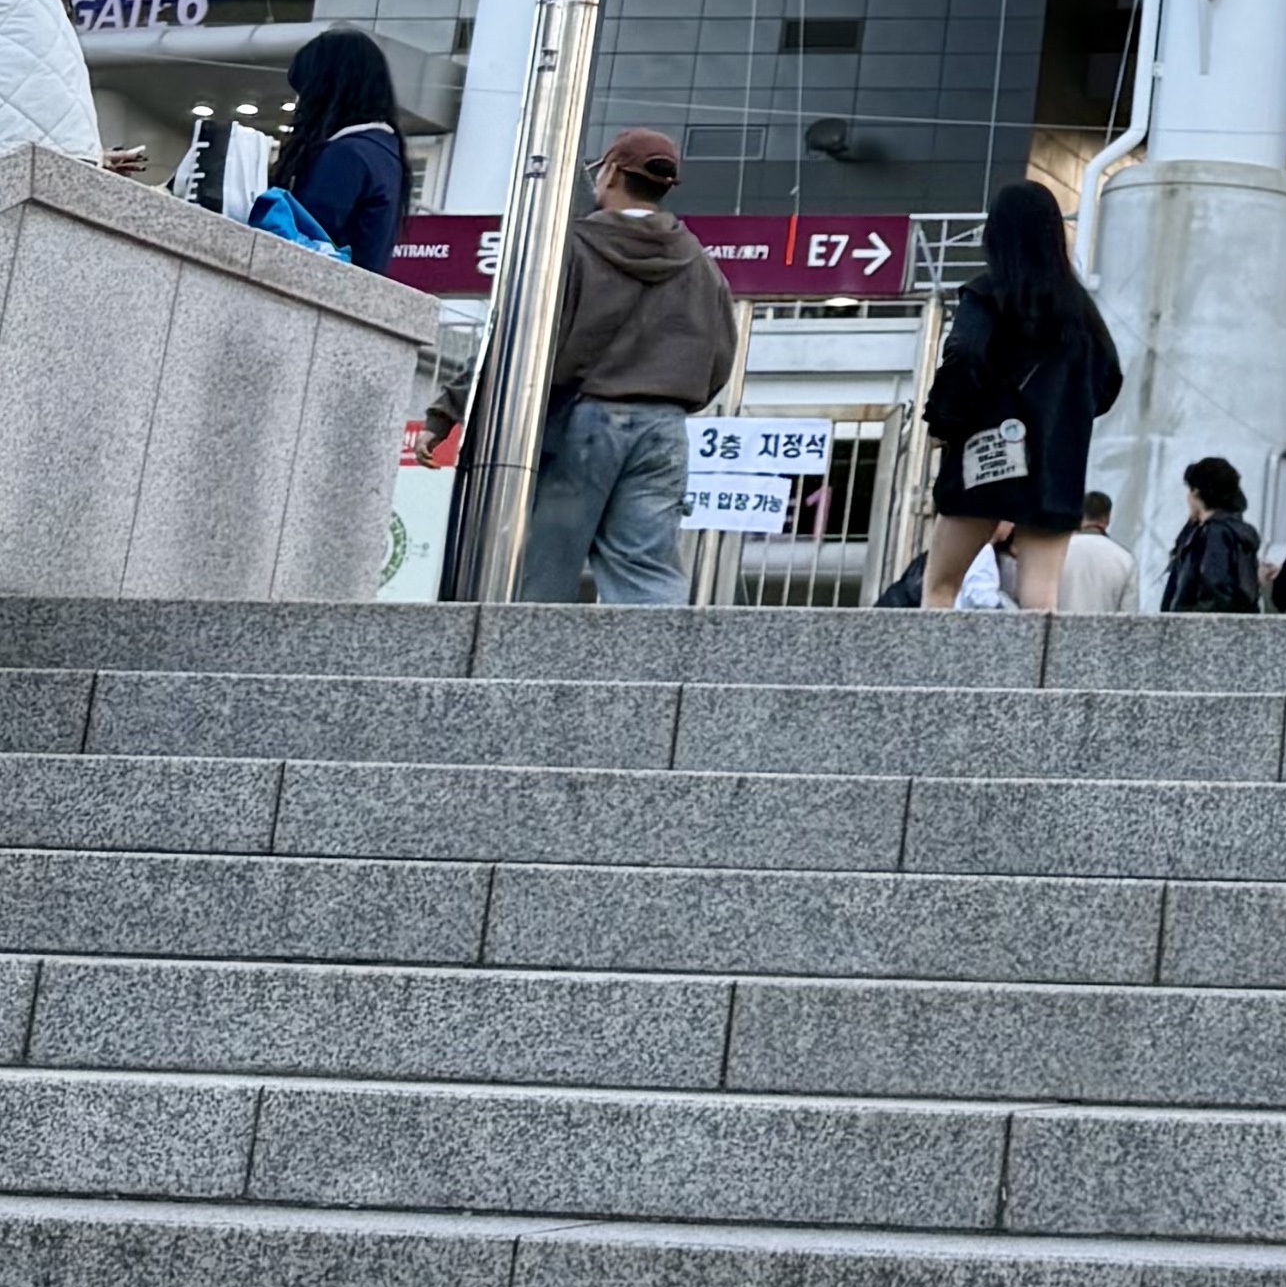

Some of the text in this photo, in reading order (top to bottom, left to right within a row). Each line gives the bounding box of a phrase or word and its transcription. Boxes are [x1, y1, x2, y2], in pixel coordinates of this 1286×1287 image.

[394, 246, 450, 258] NTRANCE
[809, 236, 849, 267] E7
[699, 427, 827, 460] 3층 지정석
